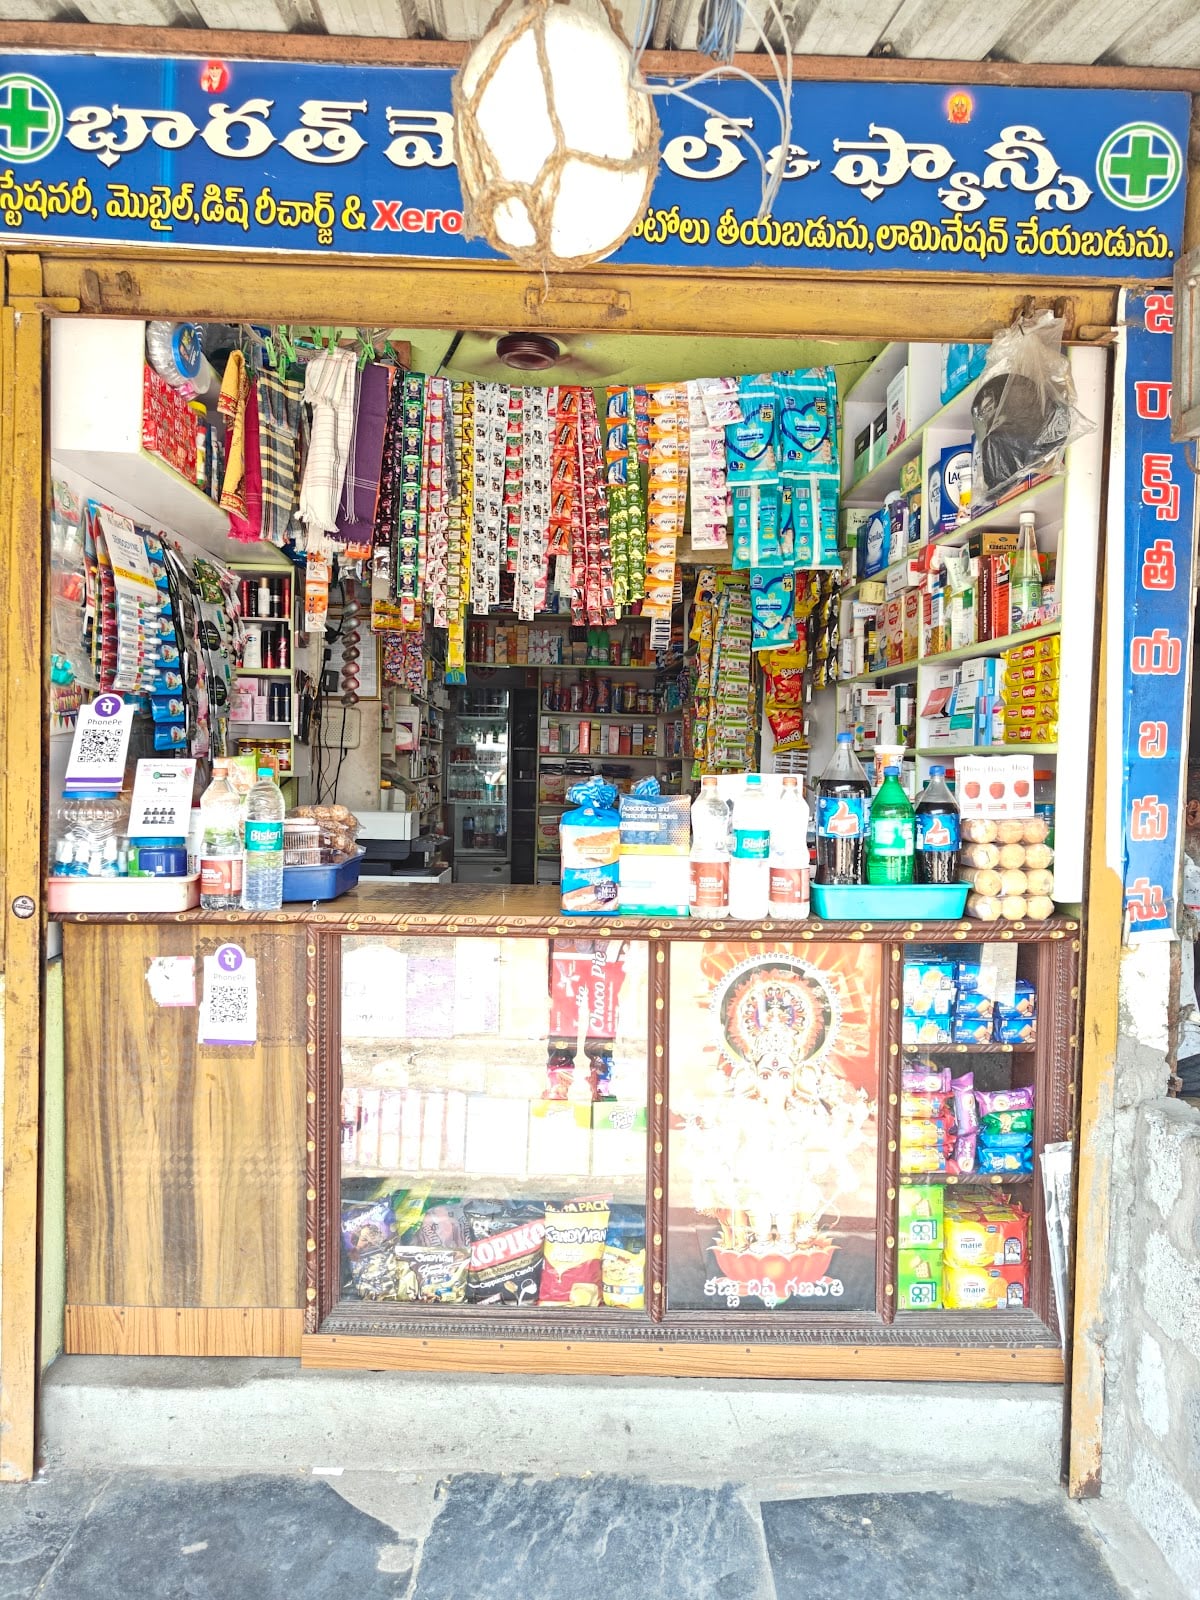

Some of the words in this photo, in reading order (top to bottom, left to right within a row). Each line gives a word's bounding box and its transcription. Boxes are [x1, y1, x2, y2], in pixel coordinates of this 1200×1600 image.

[65, 98, 369, 169] భారత్
[830, 121, 1095, 212] ఫ్యాన్సీ
[254, 186, 336, 245] రీచార్జ్
[341, 195, 367, 231] &
[371, 200, 465, 234] Xero
[87, 718, 123, 726] PhonePe
[591, 951, 607, 979] Pie
[589, 981, 606, 1033] Choco
[579, 1200, 610, 1212] PACK
[471, 1222, 546, 1268] KOPIKO
[960, 1241, 983, 1249] marie
[479, 1271, 515, 1289] Cappuccino
[514, 1266, 535, 1278] Candy
[963, 1286, 986, 1294] marie
